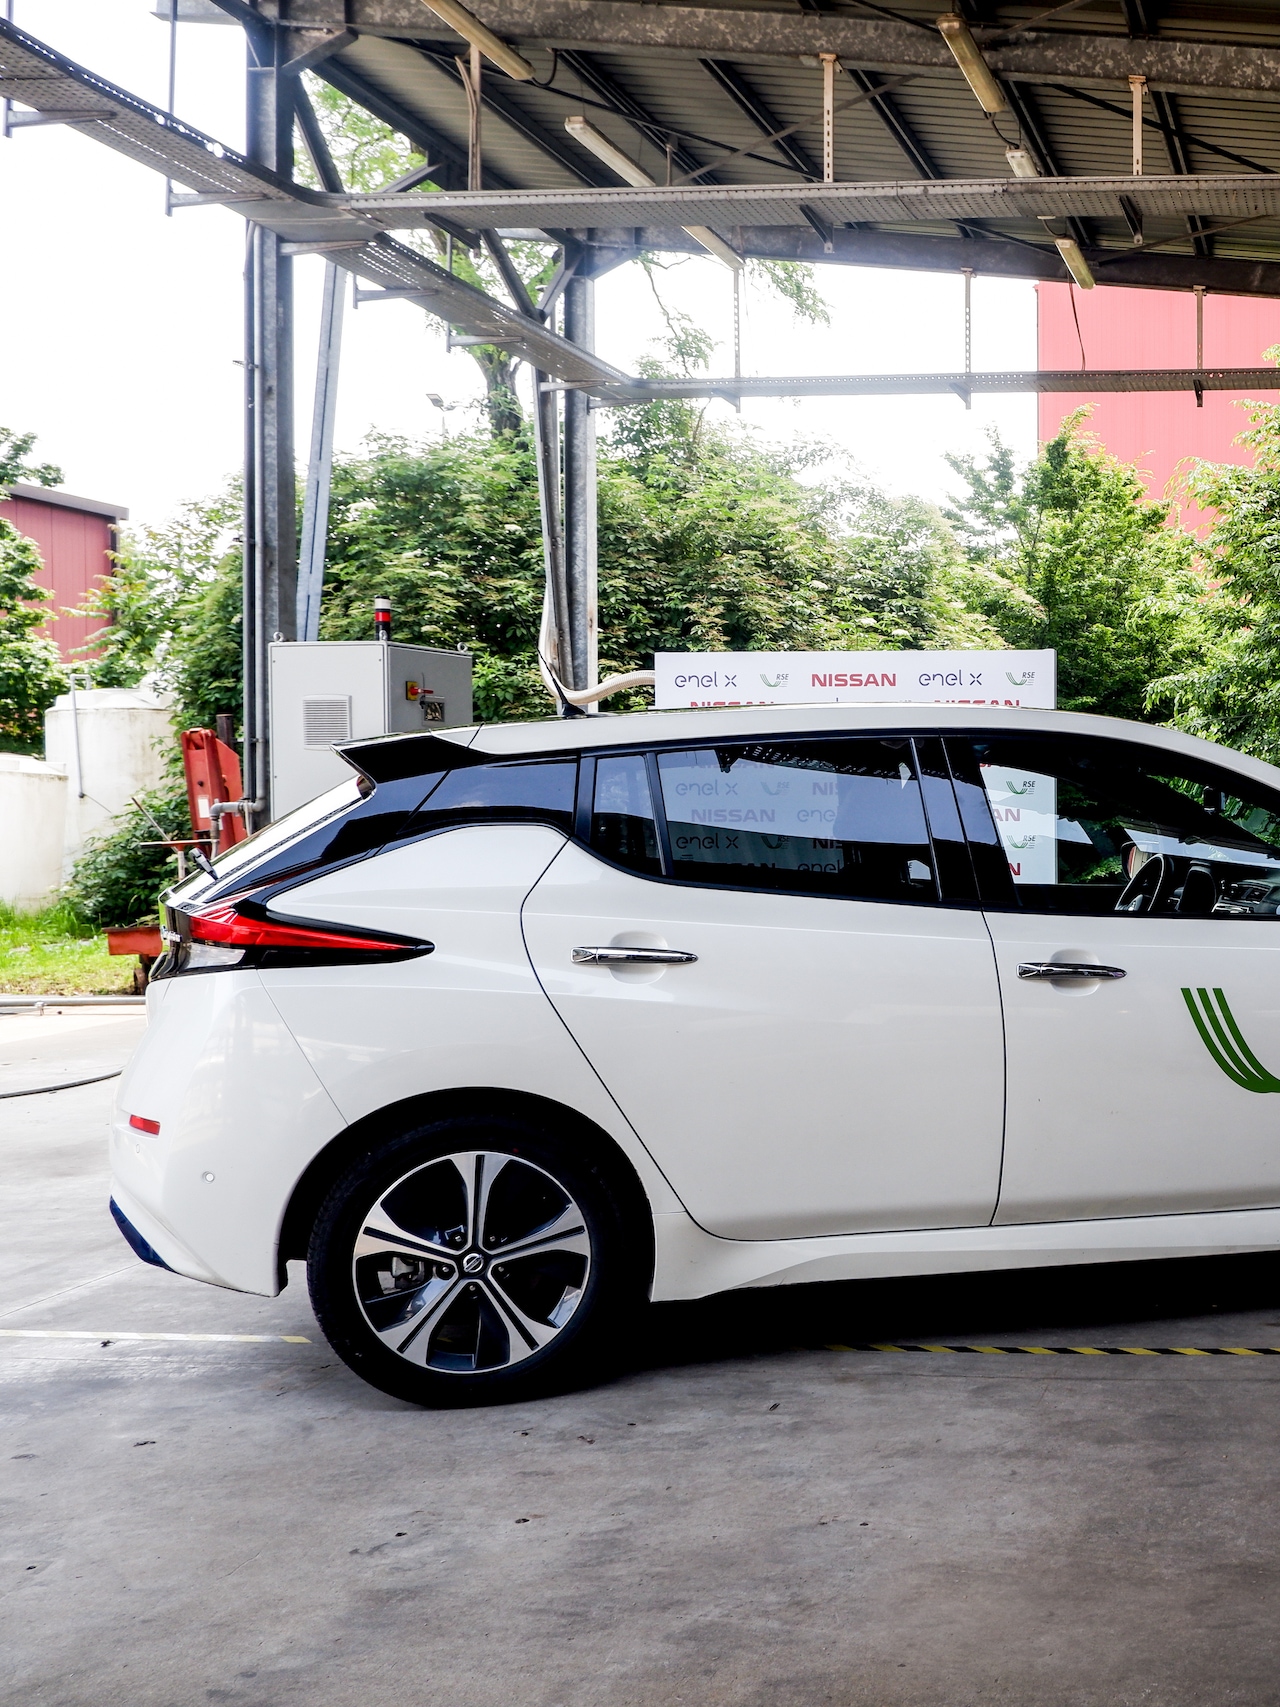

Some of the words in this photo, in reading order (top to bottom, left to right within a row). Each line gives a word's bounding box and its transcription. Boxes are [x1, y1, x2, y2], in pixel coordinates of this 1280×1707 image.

[674, 671, 718, 688] enel
[775, 673, 790, 681] RSE
[811, 673, 897, 687] NISSAN
[918, 669, 962, 687] enel
[1021, 671, 1036, 680] RSE
[675, 779, 719, 796] enel
[1022, 780, 1036, 788] RSE
[691, 808, 775, 823] NISSAN
[797, 809, 836, 823] ene
[676, 832, 720, 850] enel
